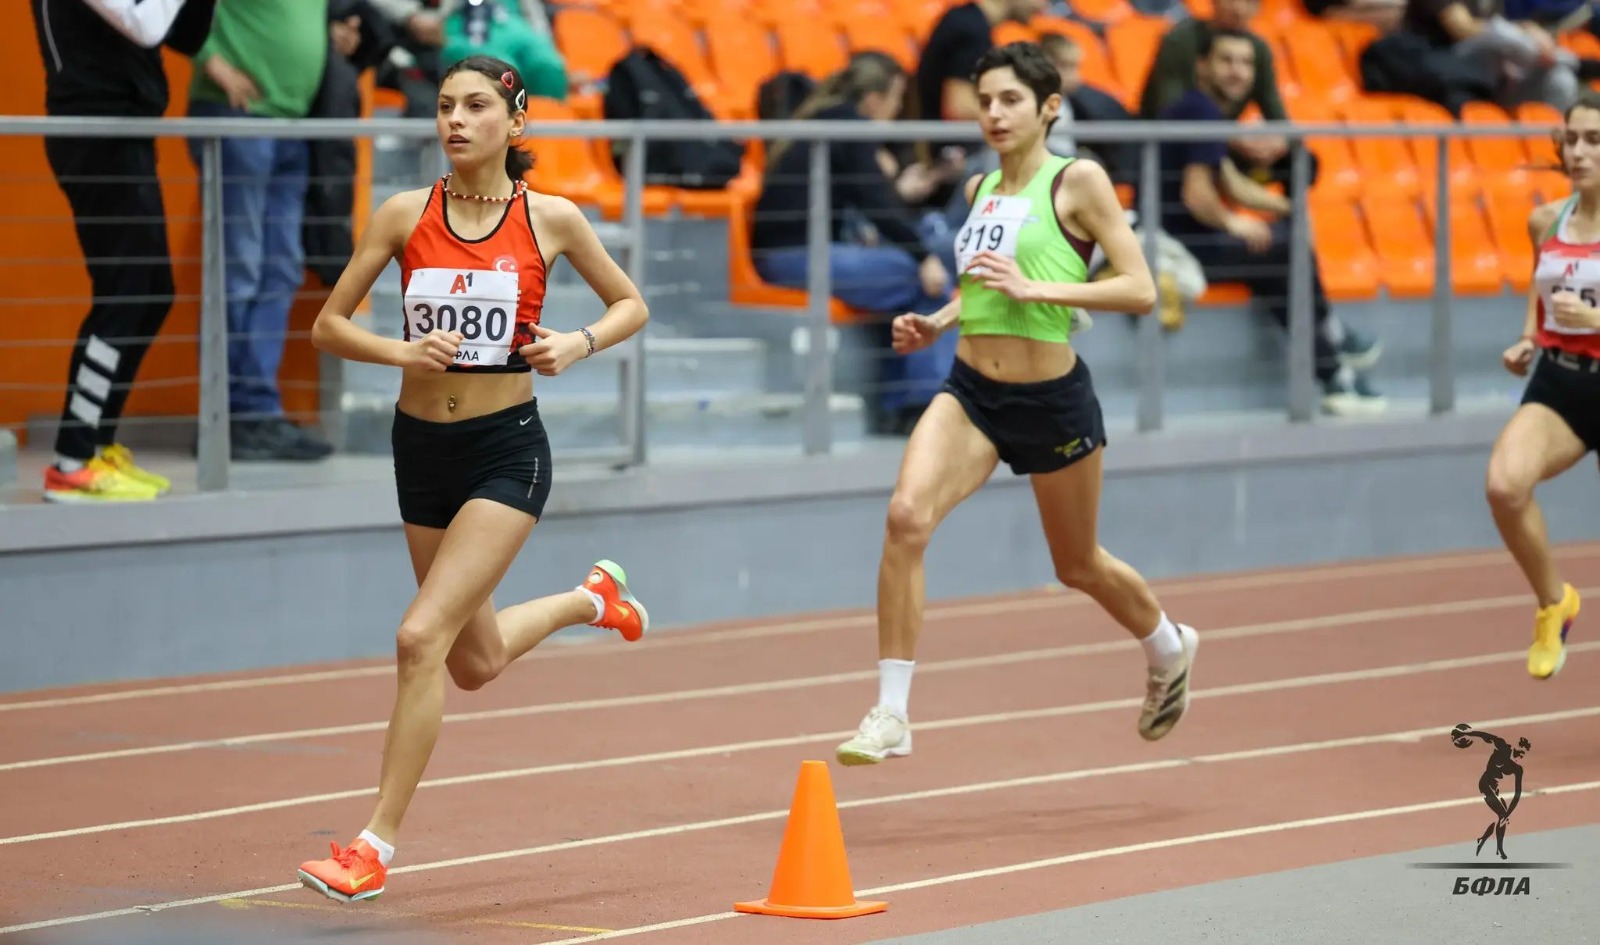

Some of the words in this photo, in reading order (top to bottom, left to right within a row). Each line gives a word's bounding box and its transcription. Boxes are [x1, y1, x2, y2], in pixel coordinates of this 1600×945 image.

[981, 199, 1001, 215] A1
[960, 224, 1004, 253] 919
[450, 273, 473, 294] A1
[414, 304, 507, 341] 3080
